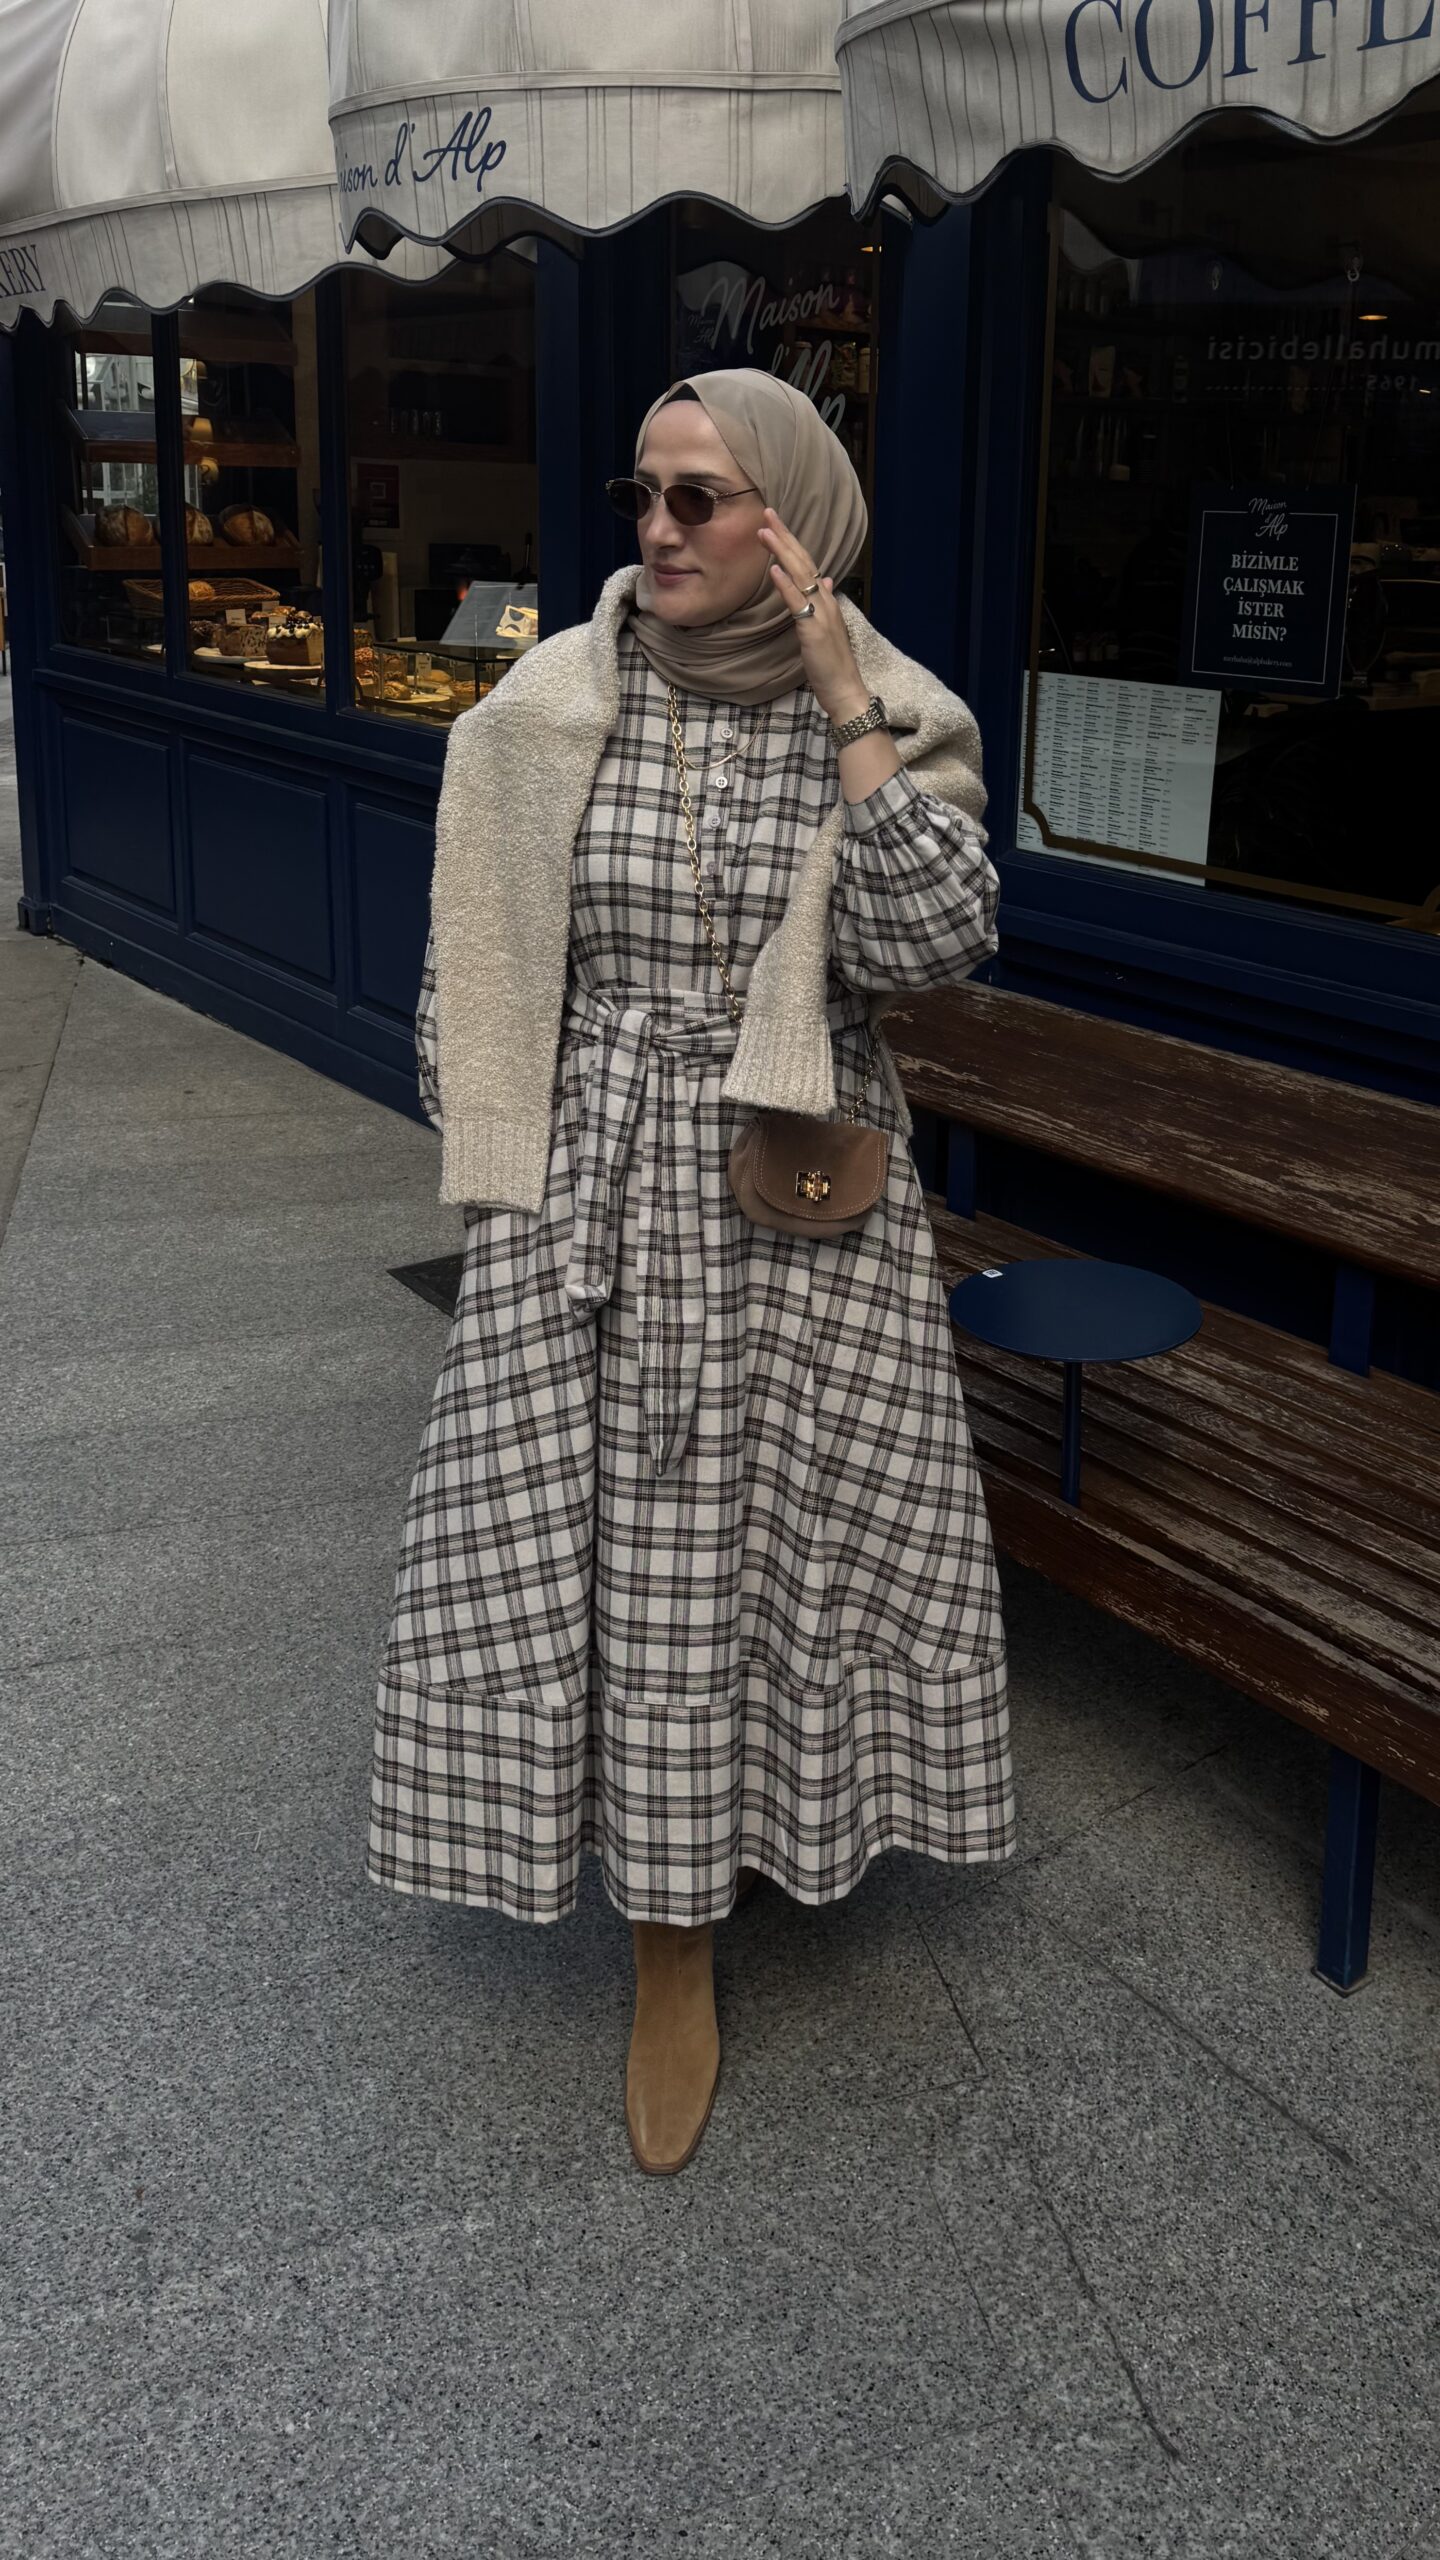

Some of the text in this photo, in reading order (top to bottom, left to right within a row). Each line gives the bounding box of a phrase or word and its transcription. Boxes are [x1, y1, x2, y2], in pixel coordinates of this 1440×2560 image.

[702, 276, 840, 355] Maison
[1231, 550, 1299, 571] BİZİMLE
[1223, 576, 1305, 597] ÇALIŞMAK
[1237, 596, 1285, 618] İSTER
[1232, 620, 1287, 641] MİSİN?
